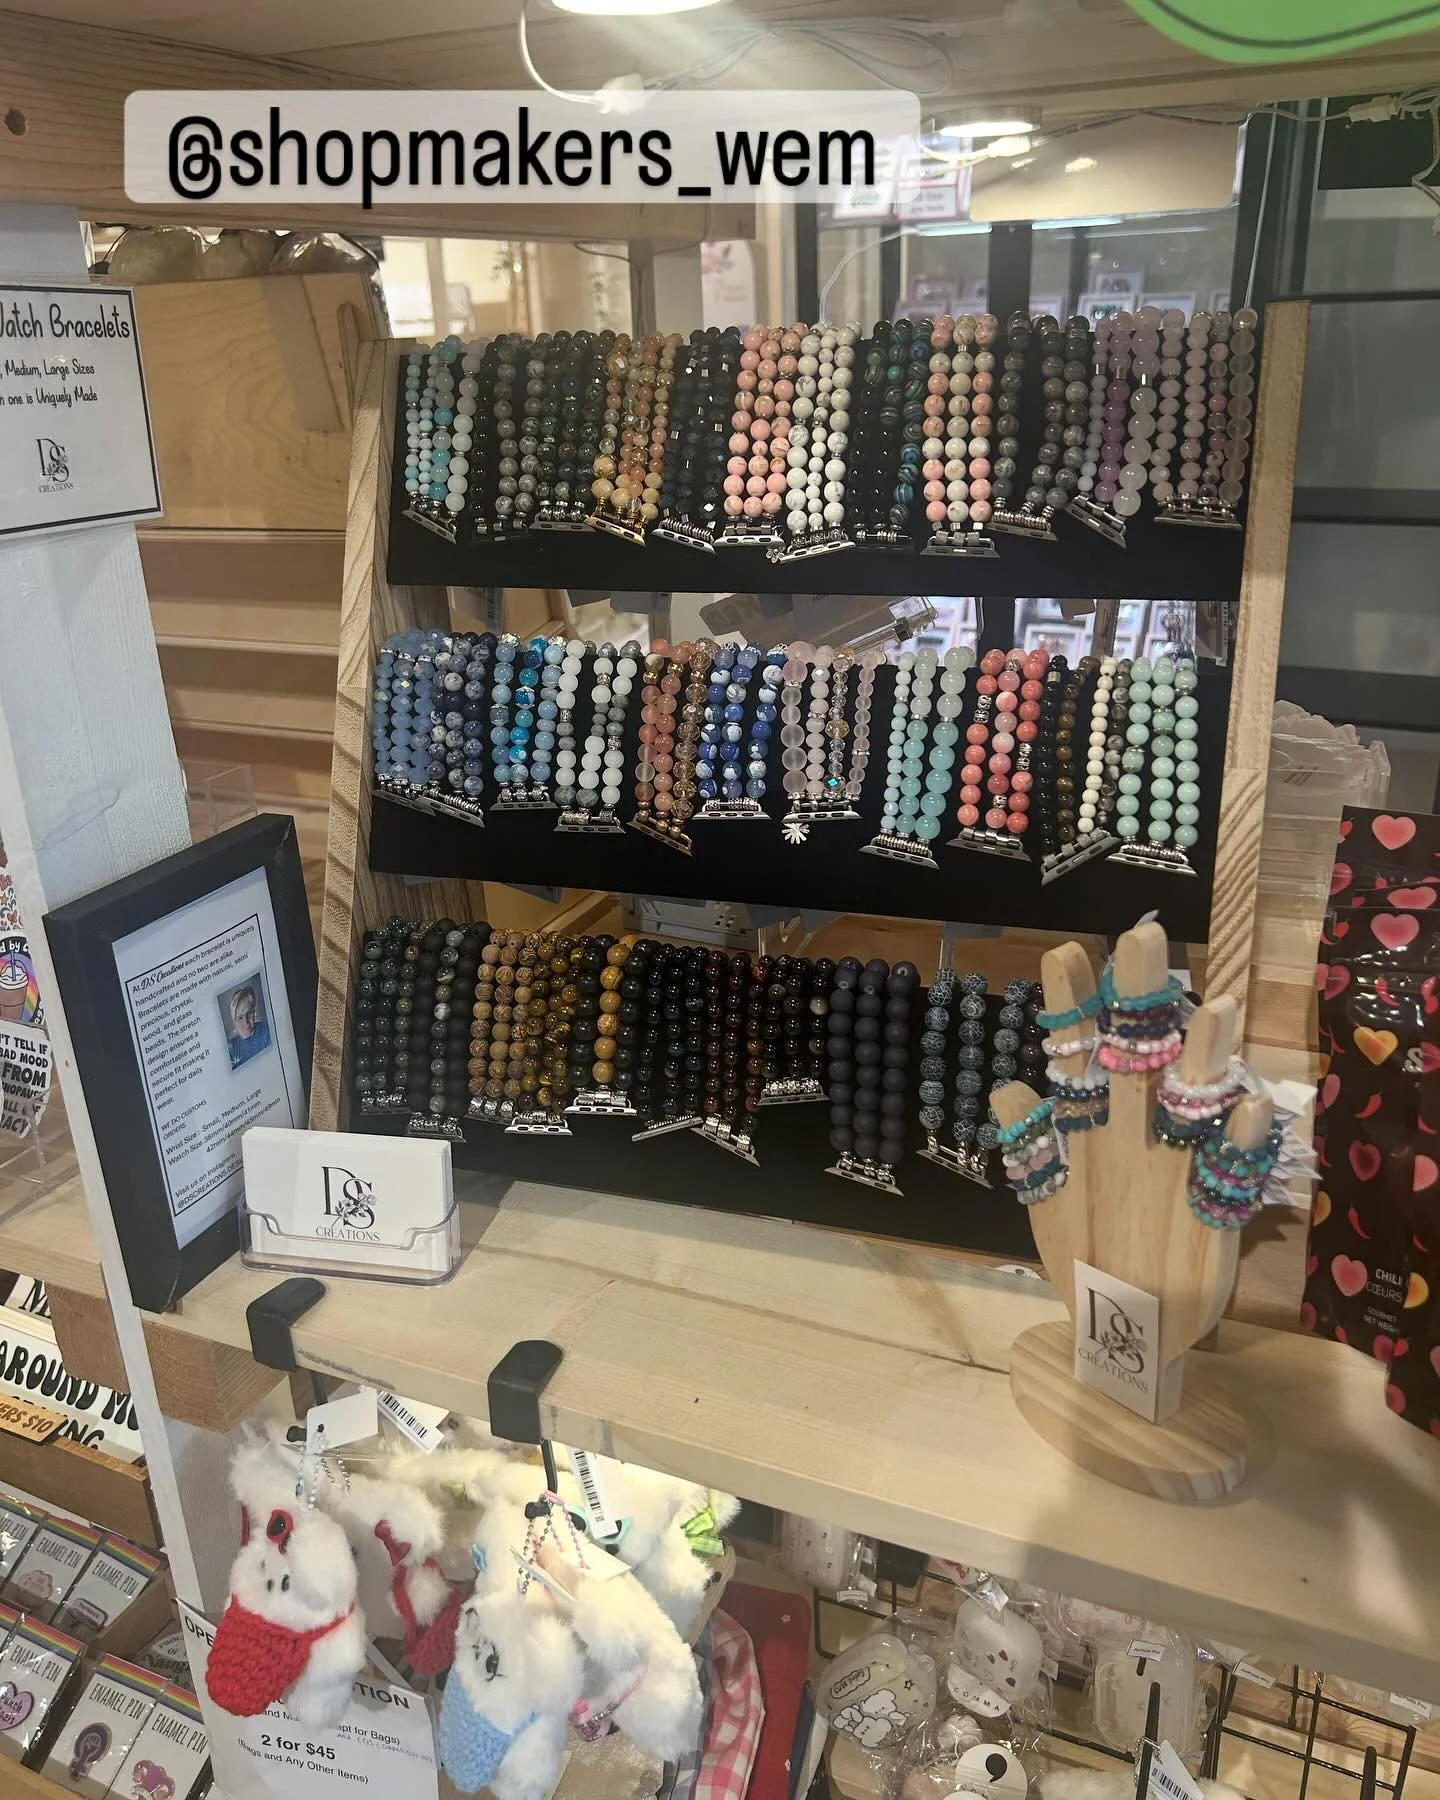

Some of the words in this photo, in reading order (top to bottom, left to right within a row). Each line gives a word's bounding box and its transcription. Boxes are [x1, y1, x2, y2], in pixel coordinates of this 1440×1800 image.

[0, 302, 44, 338] atch
[50, 303, 130, 339] Bracelets
[5, 359, 41, 379] Medium,
[43, 358, 70, 380] Large
[72, 358, 95, 374] Sizes
[8, 396, 23, 405] one
[26, 393, 33, 404] is
[35, 387, 72, 408] Uniquely
[74, 385, 98, 402] Made
[38, 481, 74, 493] CREATIONS
[9, 940, 20, 953] by
[156, 961, 185, 982] Creations
[184, 954, 201, 966] each
[200, 940, 225, 958] bracelet
[231, 924, 255, 942] uniquely
[135, 981, 176, 1007] handcrafted
[175, 974, 188, 986] and
[188, 970, 197, 979] no
[197, 964, 209, 974] two
[209, 958, 219, 968] are
[138, 998, 168, 1019] Bracelets
[169, 991, 179, 1002] are
[180, 981, 198, 997] made
[198, 973, 212, 986] with
[234, 952, 249, 966] semi
[163, 1019, 176, 1031] and
[176, 1010, 193, 1024] glass
[167, 1029, 180, 1040] The
[180, 1016, 202, 1034] stretch
[14, 1037, 36, 1052] TELL
[39, 1043, 48, 1055] IF
[20, 1053, 48, 1068] MOOD
[147, 1049, 169, 1066] design
[169, 1037, 194, 1053] ensures
[149, 1051, 189, 1077] comfortable
[188, 1041, 201, 1054] and
[2, 1062, 47, 1088] FROM
[152, 1071, 174, 1088] secure
[174, 1064, 182, 1073] fit
[182, 1053, 206, 1070] making
[154, 1081, 178, 1101] perfect
[178, 1076, 188, 1086] for
[188, 1067, 203, 1080] daily
[160, 1122, 172, 1132] WE
[171, 1115, 181, 1125] DO
[180, 1099, 207, 1118] CUSTOMS
[166, 1140, 184, 1156] Wrist
[246, 1088, 262, 1101] Large
[163, 1122, 187, 1140] ORDERS
[168, 1149, 190, 1167] Watch
[175, 1185, 190, 1198] Visit
[190, 1180, 199, 1188] us
[199, 1174, 207, 1182] on
[207, 1153, 236, 1176] Instagram
[315, 1226, 381, 1241] CREATIONS
[1078, 1347, 1148, 1393] CREATIONS
[23, 1415, 54, 1433] $10
[13, 1521, 29, 1541] PIN
[36, 1537, 66, 1562] ENAMEL
[64, 1550, 83, 1569] PIN
[92, 1560, 122, 1589] ENAMEL
[119, 1576, 139, 1596] PIN
[10, 1645, 42, 1674] ENAMEL
[42, 1659, 62, 1682] PIN
[89, 1683, 126, 1714] ENAMEL
[124, 1700, 146, 1720] PIN
[151, 1714, 189, 1745] ENAMEL
[187, 1731, 208, 1754] PIN
[261, 1733, 272, 1747] 2
[276, 1735, 300, 1751] for
[306, 1742, 336, 1761] $45
[354, 1726, 367, 1736] for
[370, 1730, 400, 1746] Bags)
[264, 1750, 283, 1763] and
[285, 1756, 305, 1769] Any
[307, 1760, 335, 1775] Other
[337, 1767, 369, 1785] Items)
